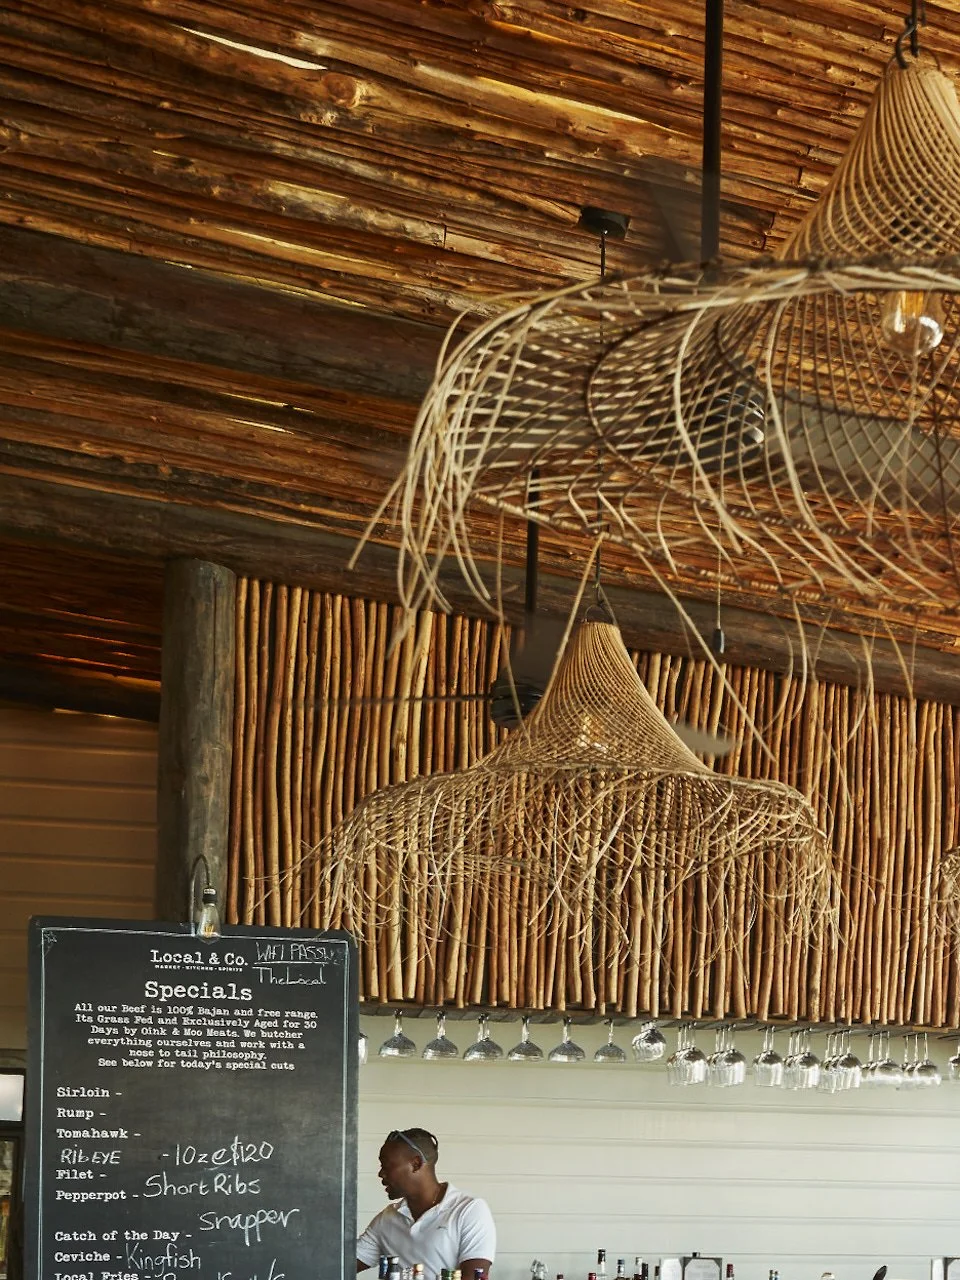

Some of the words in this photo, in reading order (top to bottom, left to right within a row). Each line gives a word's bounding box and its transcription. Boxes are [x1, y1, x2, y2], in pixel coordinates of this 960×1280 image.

[150, 949, 204, 964] Local
[208, 952, 220, 965] &
[224, 952, 249, 966] Co.
[144, 981, 253, 1001] Specials
[74, 1003, 93, 1012] All
[97, 1005, 117, 1013] our
[121, 1004, 147, 1013] Beef
[151, 1005, 162, 1014] is
[167, 1005, 194, 1015] 100%
[198, 1006, 230, 1017] Bajan
[233, 1008, 254, 1017] and
[258, 1008, 281, 1017] free
[285, 1010, 318, 1020] range.
[75, 1013, 93, 1023] Its
[97, 1015, 130, 1024] Grass
[134, 1015, 154, 1025] Fed
[158, 1016, 178, 1025] and
[182, 1016, 250, 1028] Exclusively
[254, 1019, 279, 1029] Aged
[283, 1020, 301, 1029] for
[304, 1020, 317, 1029] 30
[90, 1025, 119, 1035] Days
[123, 1026, 138, 1036] by
[141, 1027, 167, 1036] Oink
[172, 1027, 180, 1036] &
[183, 1028, 203, 1036] Moo
[206, 1028, 240, 1038] Meats.
[243, 1029, 256, 1038] We
[260, 1029, 303, 1039] butcher
[87, 1037, 153, 1048] everything
[157, 1038, 212, 1047] ourselves
[215, 1039, 236, 1048] and
[240, 1040, 266, 1049] work
[270, 1041, 295, 1049] with
[128, 1049, 155, 1057] nose
[158, 1048, 171, 1057] to
[174, 1049, 198, 1058] tail
[202, 1050, 267, 1061] philosophy.
[98, 1058, 118, 1067] See
[121, 1058, 154, 1068] below
[157, 1059, 176, 1068] for
[180, 1059, 222, 1070] today's
[226, 1061, 267, 1071] special
[270, 1061, 296, 1071] cuts
[56, 1086, 110, 1098] Sirloin
[56, 1107, 94, 1120] Rump
[56, 1128, 128, 1139] Tomahawk
[55, 1169, 94, 1180] Filet
[143, 1171, 209, 1198] Short
[213, 1173, 261, 1195] Ribs
[55, 1190, 127, 1202] Pepperpot
[54, 1230, 97, 1241] Catch
[102, 1230, 119, 1241] of
[124, 1230, 149, 1241] the
[152, 1230, 180, 1242] Day
[54, 1251, 111, 1262] Ceviche
[125, 1242, 201, 1277] Kingfish
